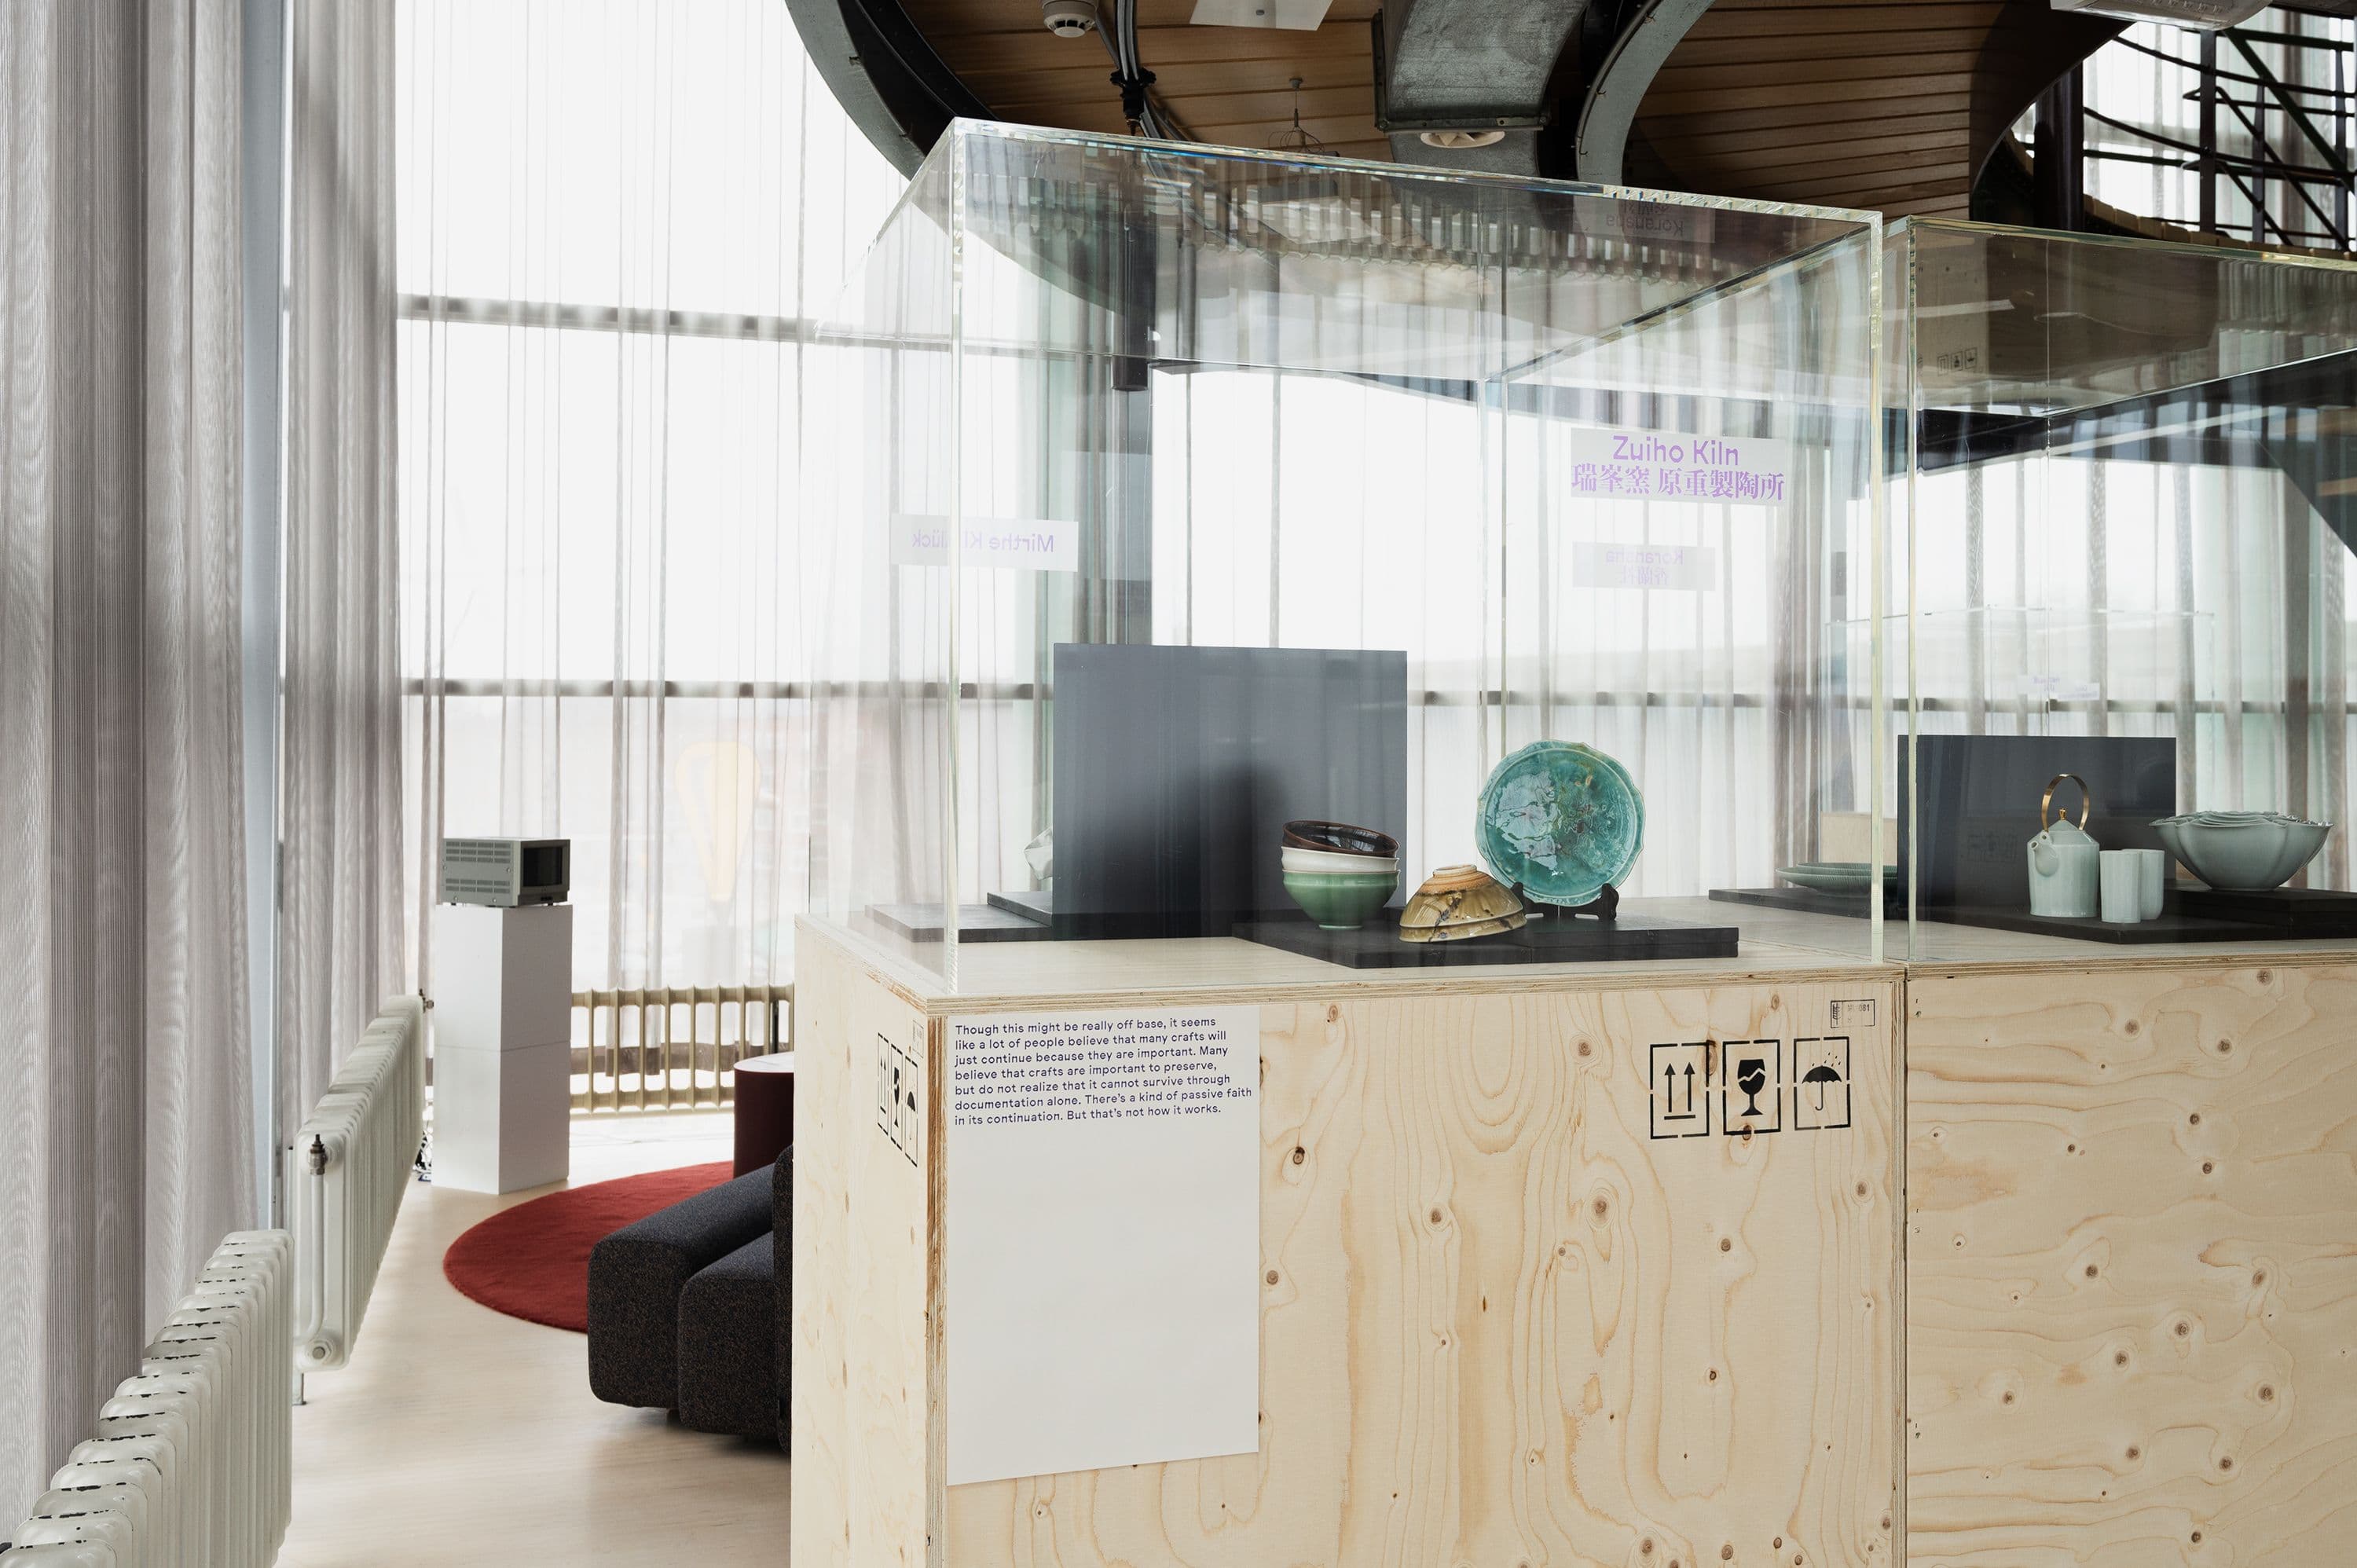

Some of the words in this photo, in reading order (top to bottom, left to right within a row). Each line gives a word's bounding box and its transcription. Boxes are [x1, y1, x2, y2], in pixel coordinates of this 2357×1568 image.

[1613, 435, 1684, 463] Zuiho
[1693, 440, 1739, 466] Kiln
[1658, 467, 1785, 500] 原重製陶所
[955, 1024, 999, 1036] Though
[1003, 1023, 1024, 1033] this
[1028, 1022, 1061, 1035] might
[1065, 1022, 1078, 1031] be
[1083, 1020, 1113, 1032] really
[1117, 1020, 1134, 1029] off
[1137, 1020, 1166, 1029] base,
[1170, 1017, 1177, 1028] it
[955, 1040, 975, 1050] like
[989, 1039, 1005, 1049] lot
[1009, 1038, 1021, 1048] of
[1025, 1037, 1065, 1050] people
[1069, 1035, 1109, 1046] believe
[1113, 1035, 1135, 1044] that
[1139, 1035, 1168, 1045] many
[1171, 1031, 1204, 1042] crafts
[1208, 1031, 1226, 1040] will
[955, 1055, 977, 1068] just
[981, 1053, 1032, 1064] continue
[1036, 1053, 1084, 1062] because
[1087, 1050, 1113, 1061] they
[1138, 1047, 1196, 1060] important.
[1200, 1046, 1228, 1057] Many
[955, 1069, 997, 1080] believe
[1001, 1068, 1025, 1078] that
[1028, 1067, 1064, 1077] crafts
[1089, 1064, 1146, 1076] important
[1149, 1064, 1160, 1072] to
[1164, 1062, 1216, 1074] preserve,
[955, 1086, 975, 1095] but
[979, 1084, 993, 1094] do
[998, 1084, 1017, 1094] not
[1021, 1082, 1058, 1092] realize
[1062, 1081, 1086, 1090] that
[1089, 1079, 1097, 1089] it
[1101, 1079, 1139, 1089] cannot
[1143, 1076, 1183, 1087] survive
[1187, 1074, 1230, 1086] through
[955, 1097, 1043, 1110] documentation
[1047, 1097, 1081, 1106] alone.
[1139, 1091, 1162, 1101] kind
[1166, 1090, 1178, 1101] of
[1182, 1089, 1223, 1101] passive
[1226, 1087, 1252, 1097] faith
[955, 1116, 965, 1125] in
[969, 1115, 983, 1125] its
[987, 1111, 1063, 1124] continuation.
[1067, 1110, 1087, 1119] But
[1126, 1108, 1144, 1117] not
[1148, 1107, 1170, 1116] how
[1174, 1105, 1181, 1115] it
[1185, 1104, 1221, 1114] works.
